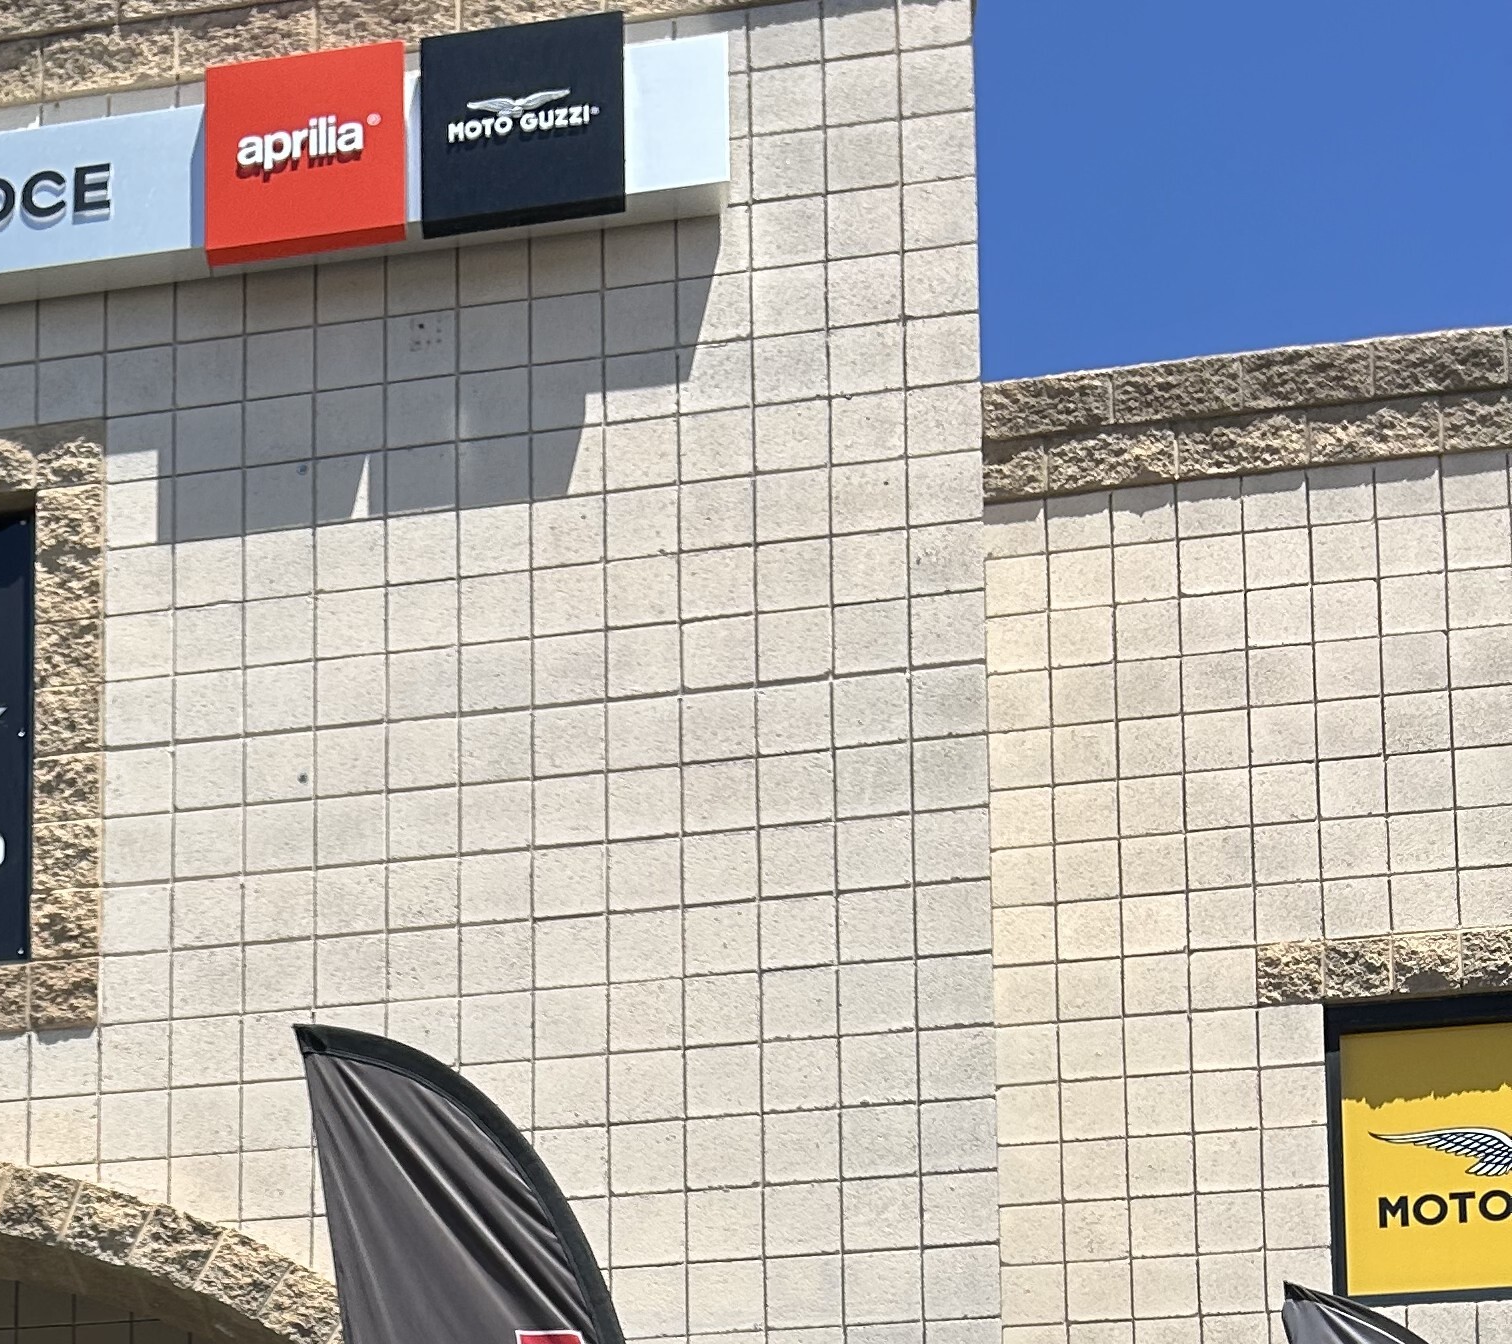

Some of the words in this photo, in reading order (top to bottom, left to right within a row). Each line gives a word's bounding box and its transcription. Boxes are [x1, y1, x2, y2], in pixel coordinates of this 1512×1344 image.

[237, 115, 364, 171] aprilia
[448, 115, 513, 143] MOTO
[519, 104, 590, 132] GUZZI
[1378, 1189, 1512, 1228] MOTO
